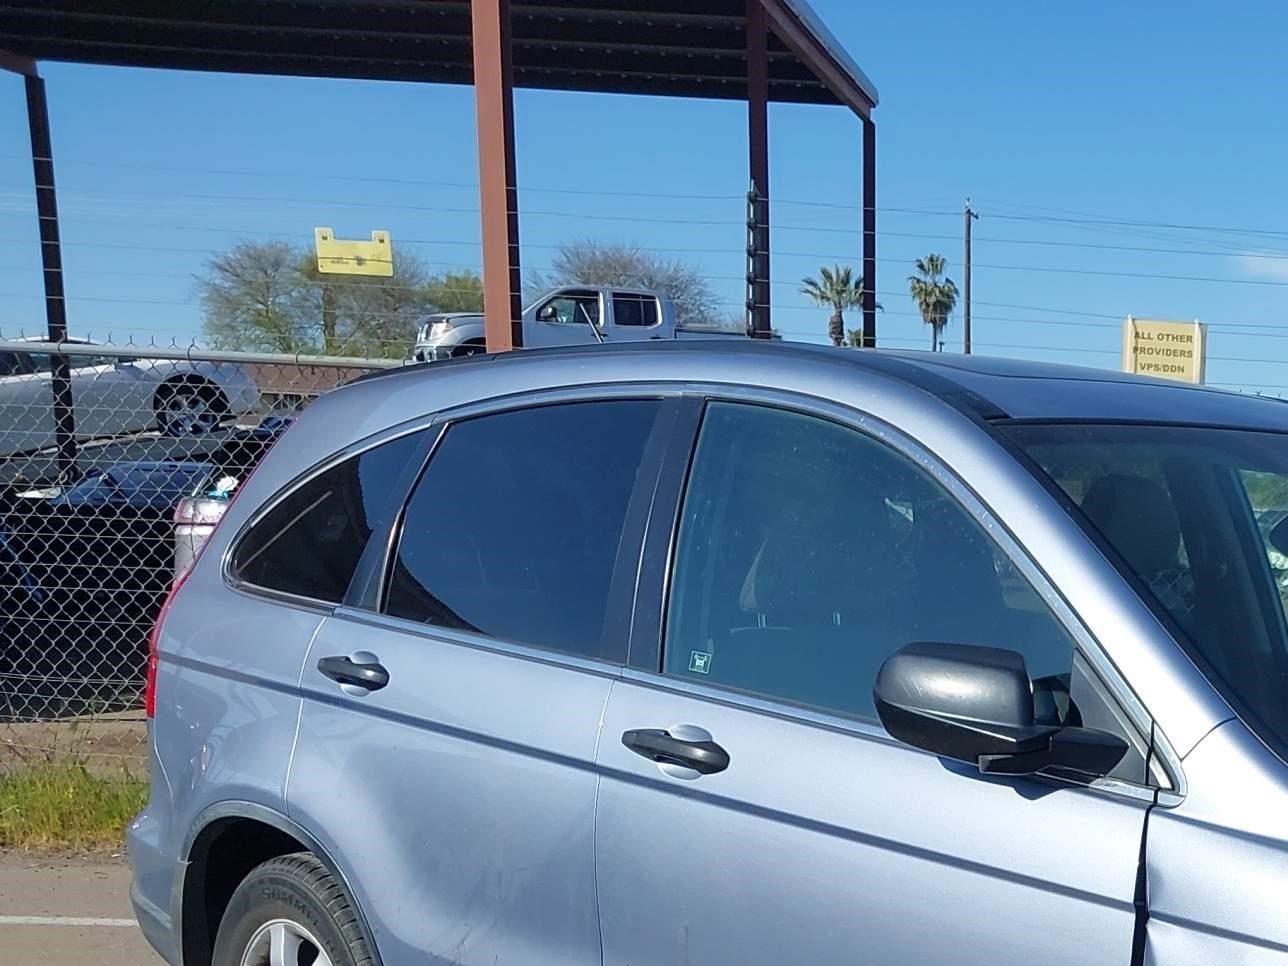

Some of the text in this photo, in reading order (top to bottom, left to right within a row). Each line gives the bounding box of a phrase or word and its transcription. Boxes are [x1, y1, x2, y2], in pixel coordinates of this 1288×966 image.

[1134, 331, 1193, 343] ALL OTHER
[1133, 346, 1193, 358] PROVIDERS
[1139, 362, 1185, 373] VPS/DDN
